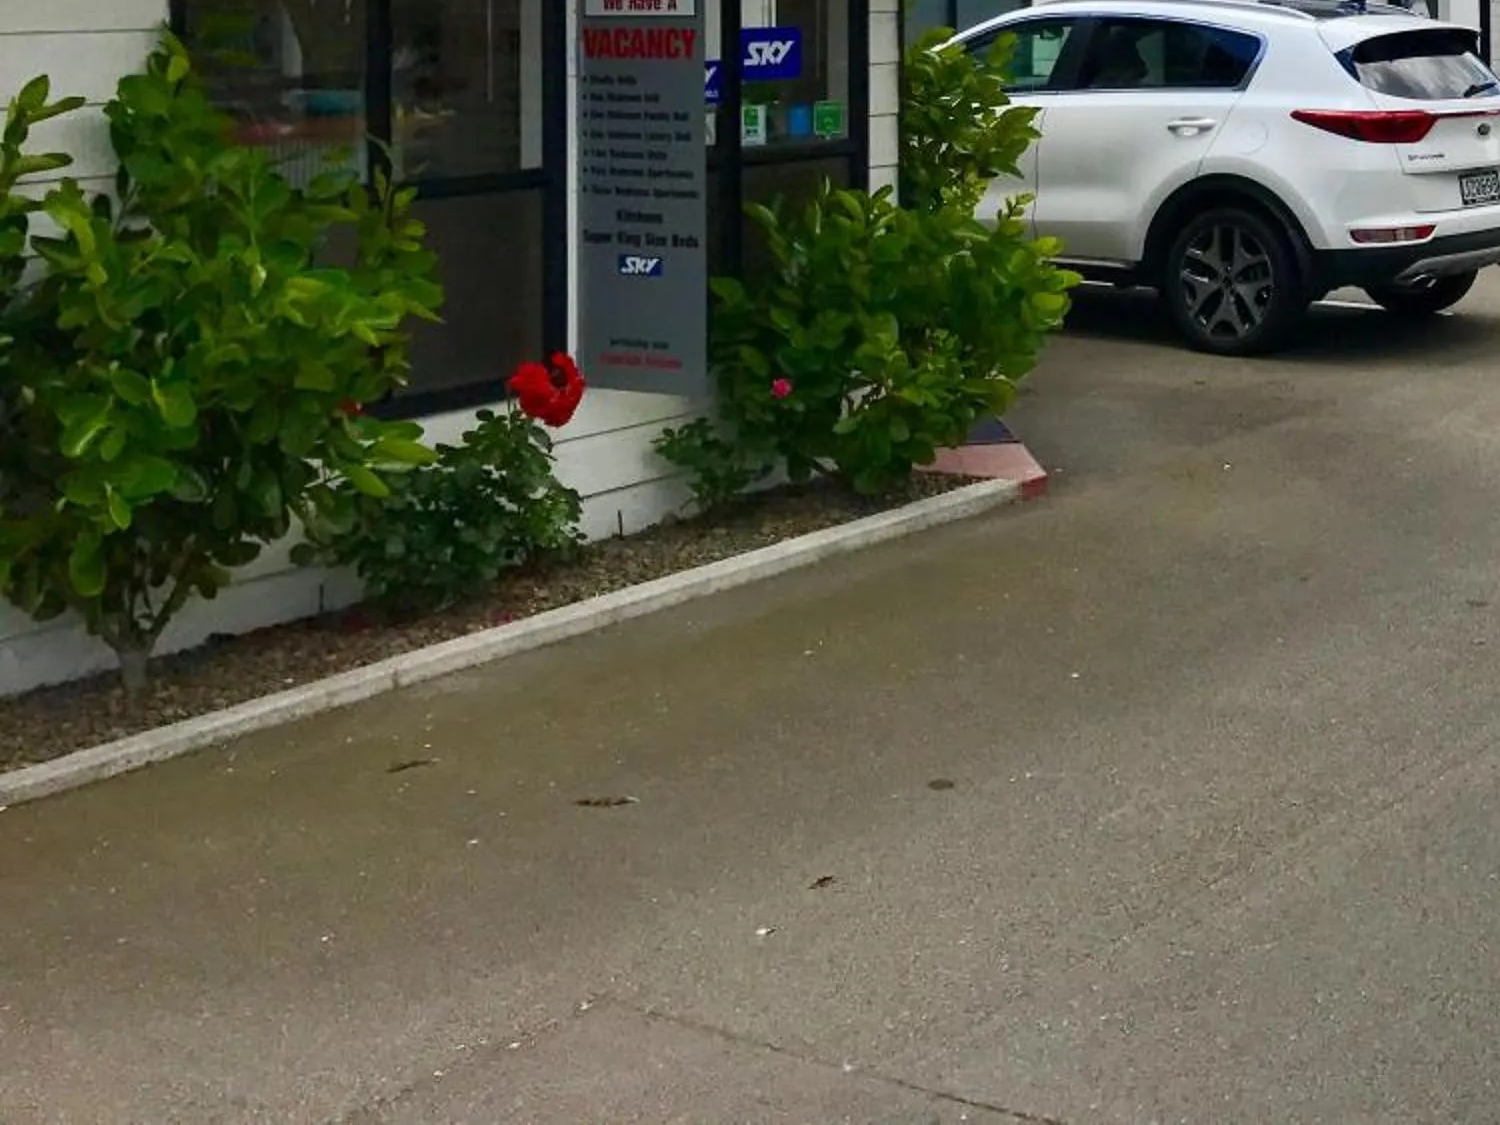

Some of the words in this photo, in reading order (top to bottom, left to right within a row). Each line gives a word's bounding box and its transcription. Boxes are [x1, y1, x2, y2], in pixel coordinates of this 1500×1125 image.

[583, 28, 697, 59] VACANCY
[743, 40, 796, 66] SKY
[620, 256, 660, 274] SKY
